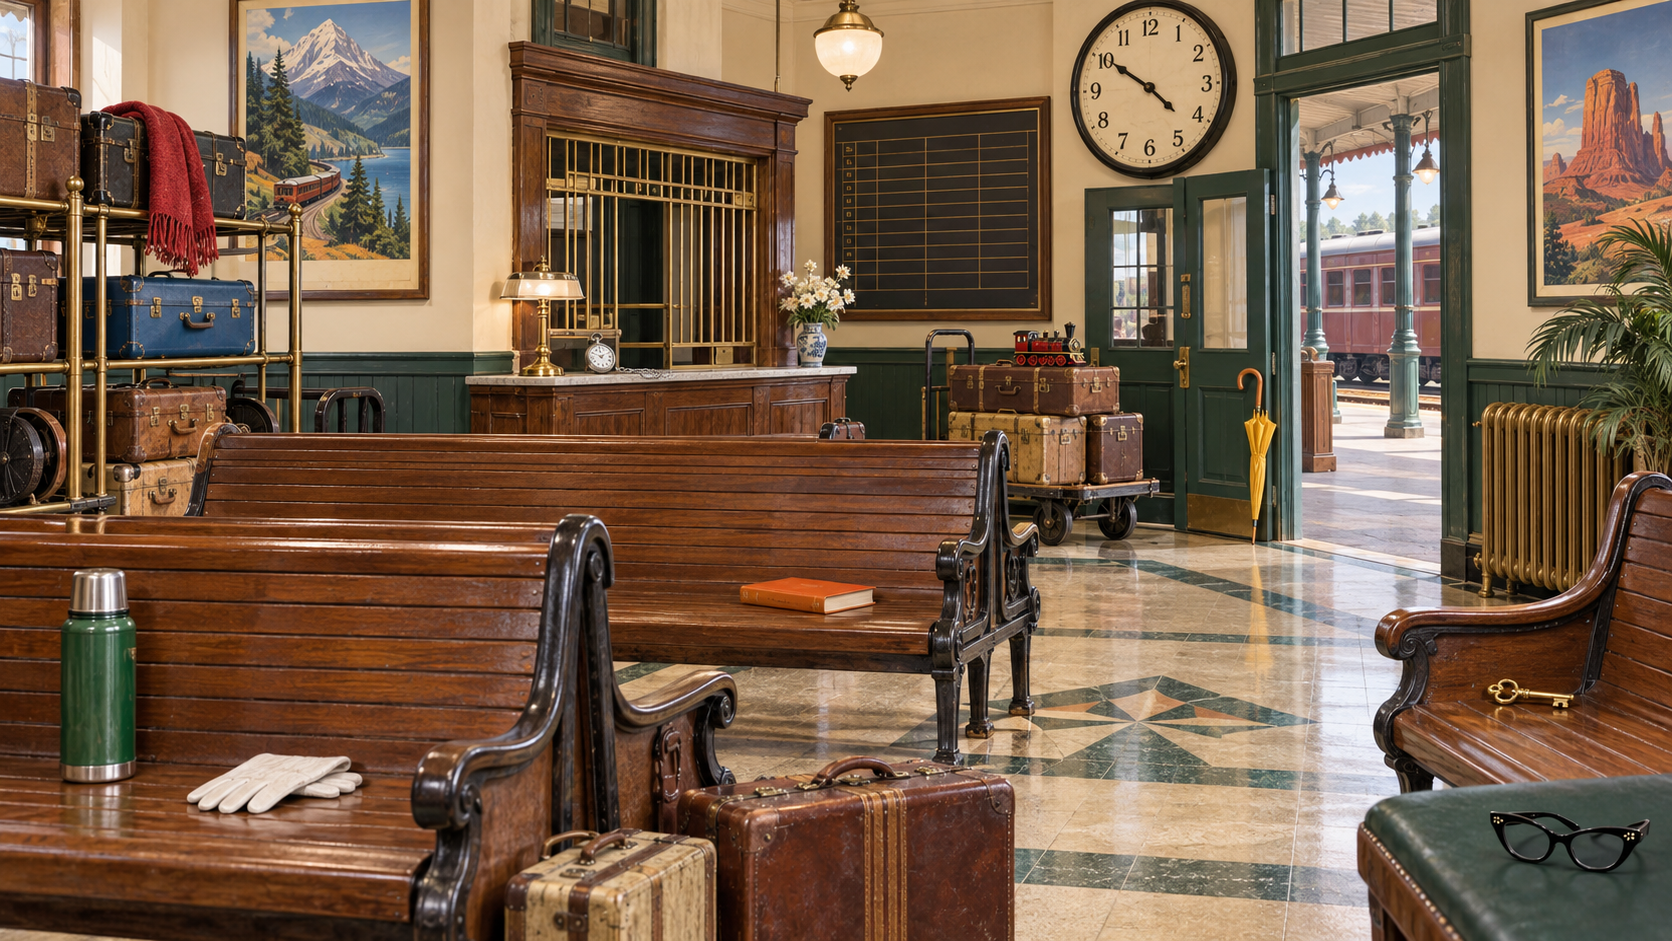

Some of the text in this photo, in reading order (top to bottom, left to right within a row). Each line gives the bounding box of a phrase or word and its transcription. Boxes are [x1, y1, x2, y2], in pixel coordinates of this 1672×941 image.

[1142, 19, 1159, 37] 12
[1175, 25, 1181, 42] 1
[1118, 29, 1130, 46] 11
[1098, 52, 1114, 69] 10
[1193, 44, 1204, 62] 2
[1090, 82, 1101, 100] 9
[1201, 75, 1212, 92] 3
[1098, 112, 1109, 128] 8
[1192, 106, 1204, 123] 4
[1118, 133, 1128, 149] 7
[1173, 130, 1184, 147] 5
[1144, 139, 1155, 156] 6
